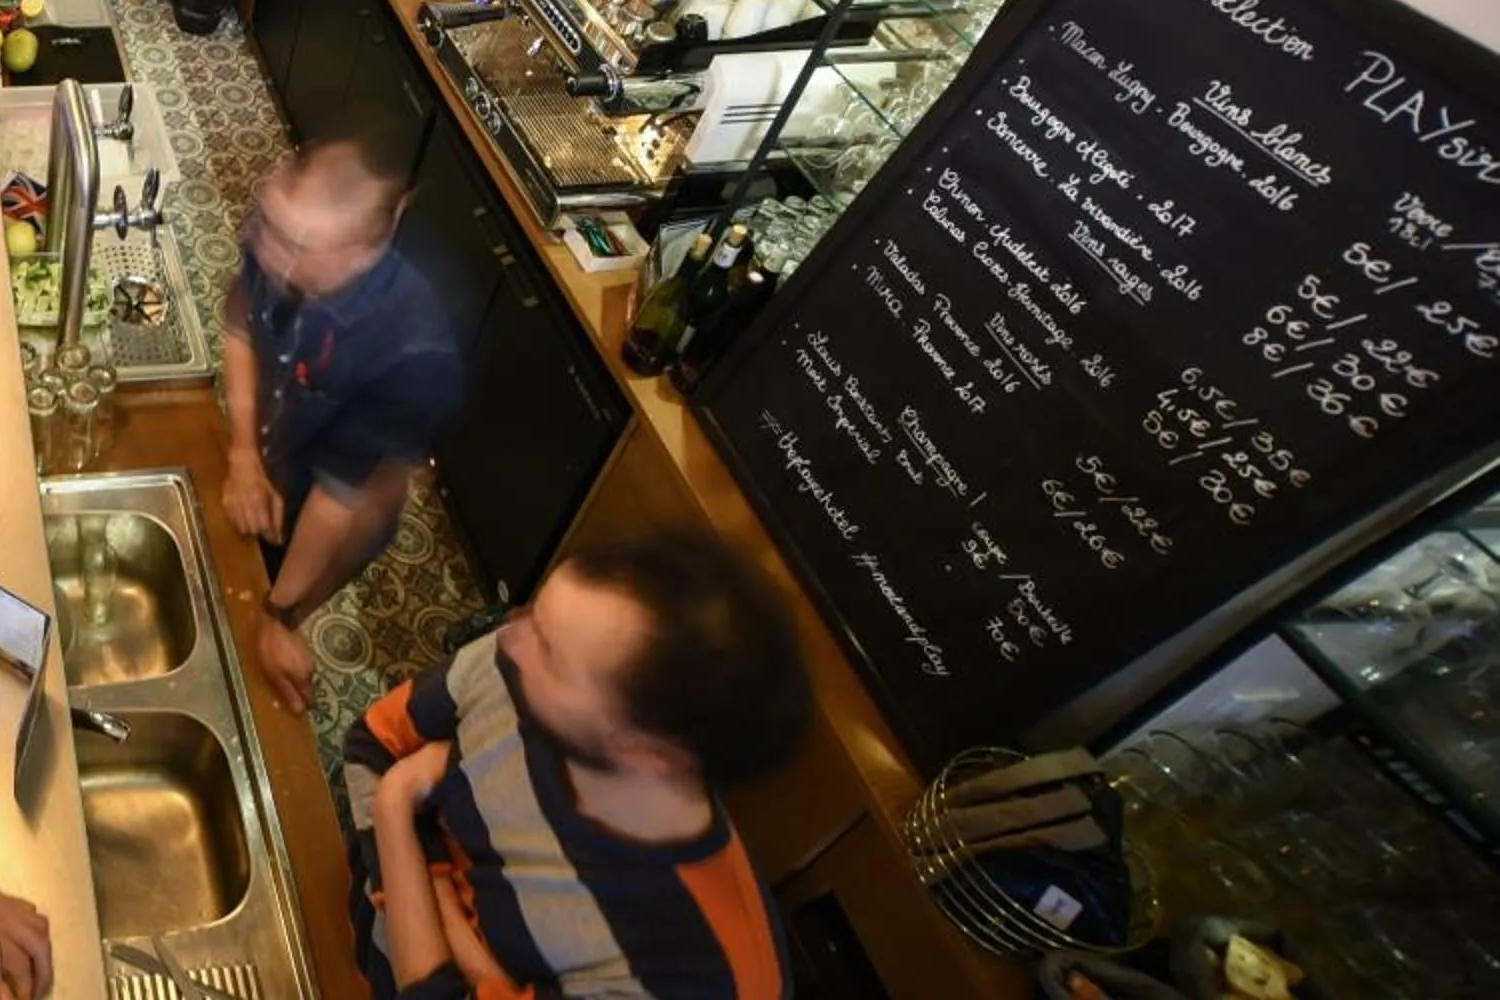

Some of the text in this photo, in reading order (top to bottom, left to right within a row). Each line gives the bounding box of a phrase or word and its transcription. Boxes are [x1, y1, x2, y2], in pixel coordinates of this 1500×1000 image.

[1204, 80, 1333, 184] Vins blancs
[1248, 175, 1300, 211] 2016
[1147, 199, 1197, 237] 2017
[1049, 282, 1088, 315] 2016
[1160, 264, 1204, 300] 2016
[982, 357, 1021, 393] 2016
